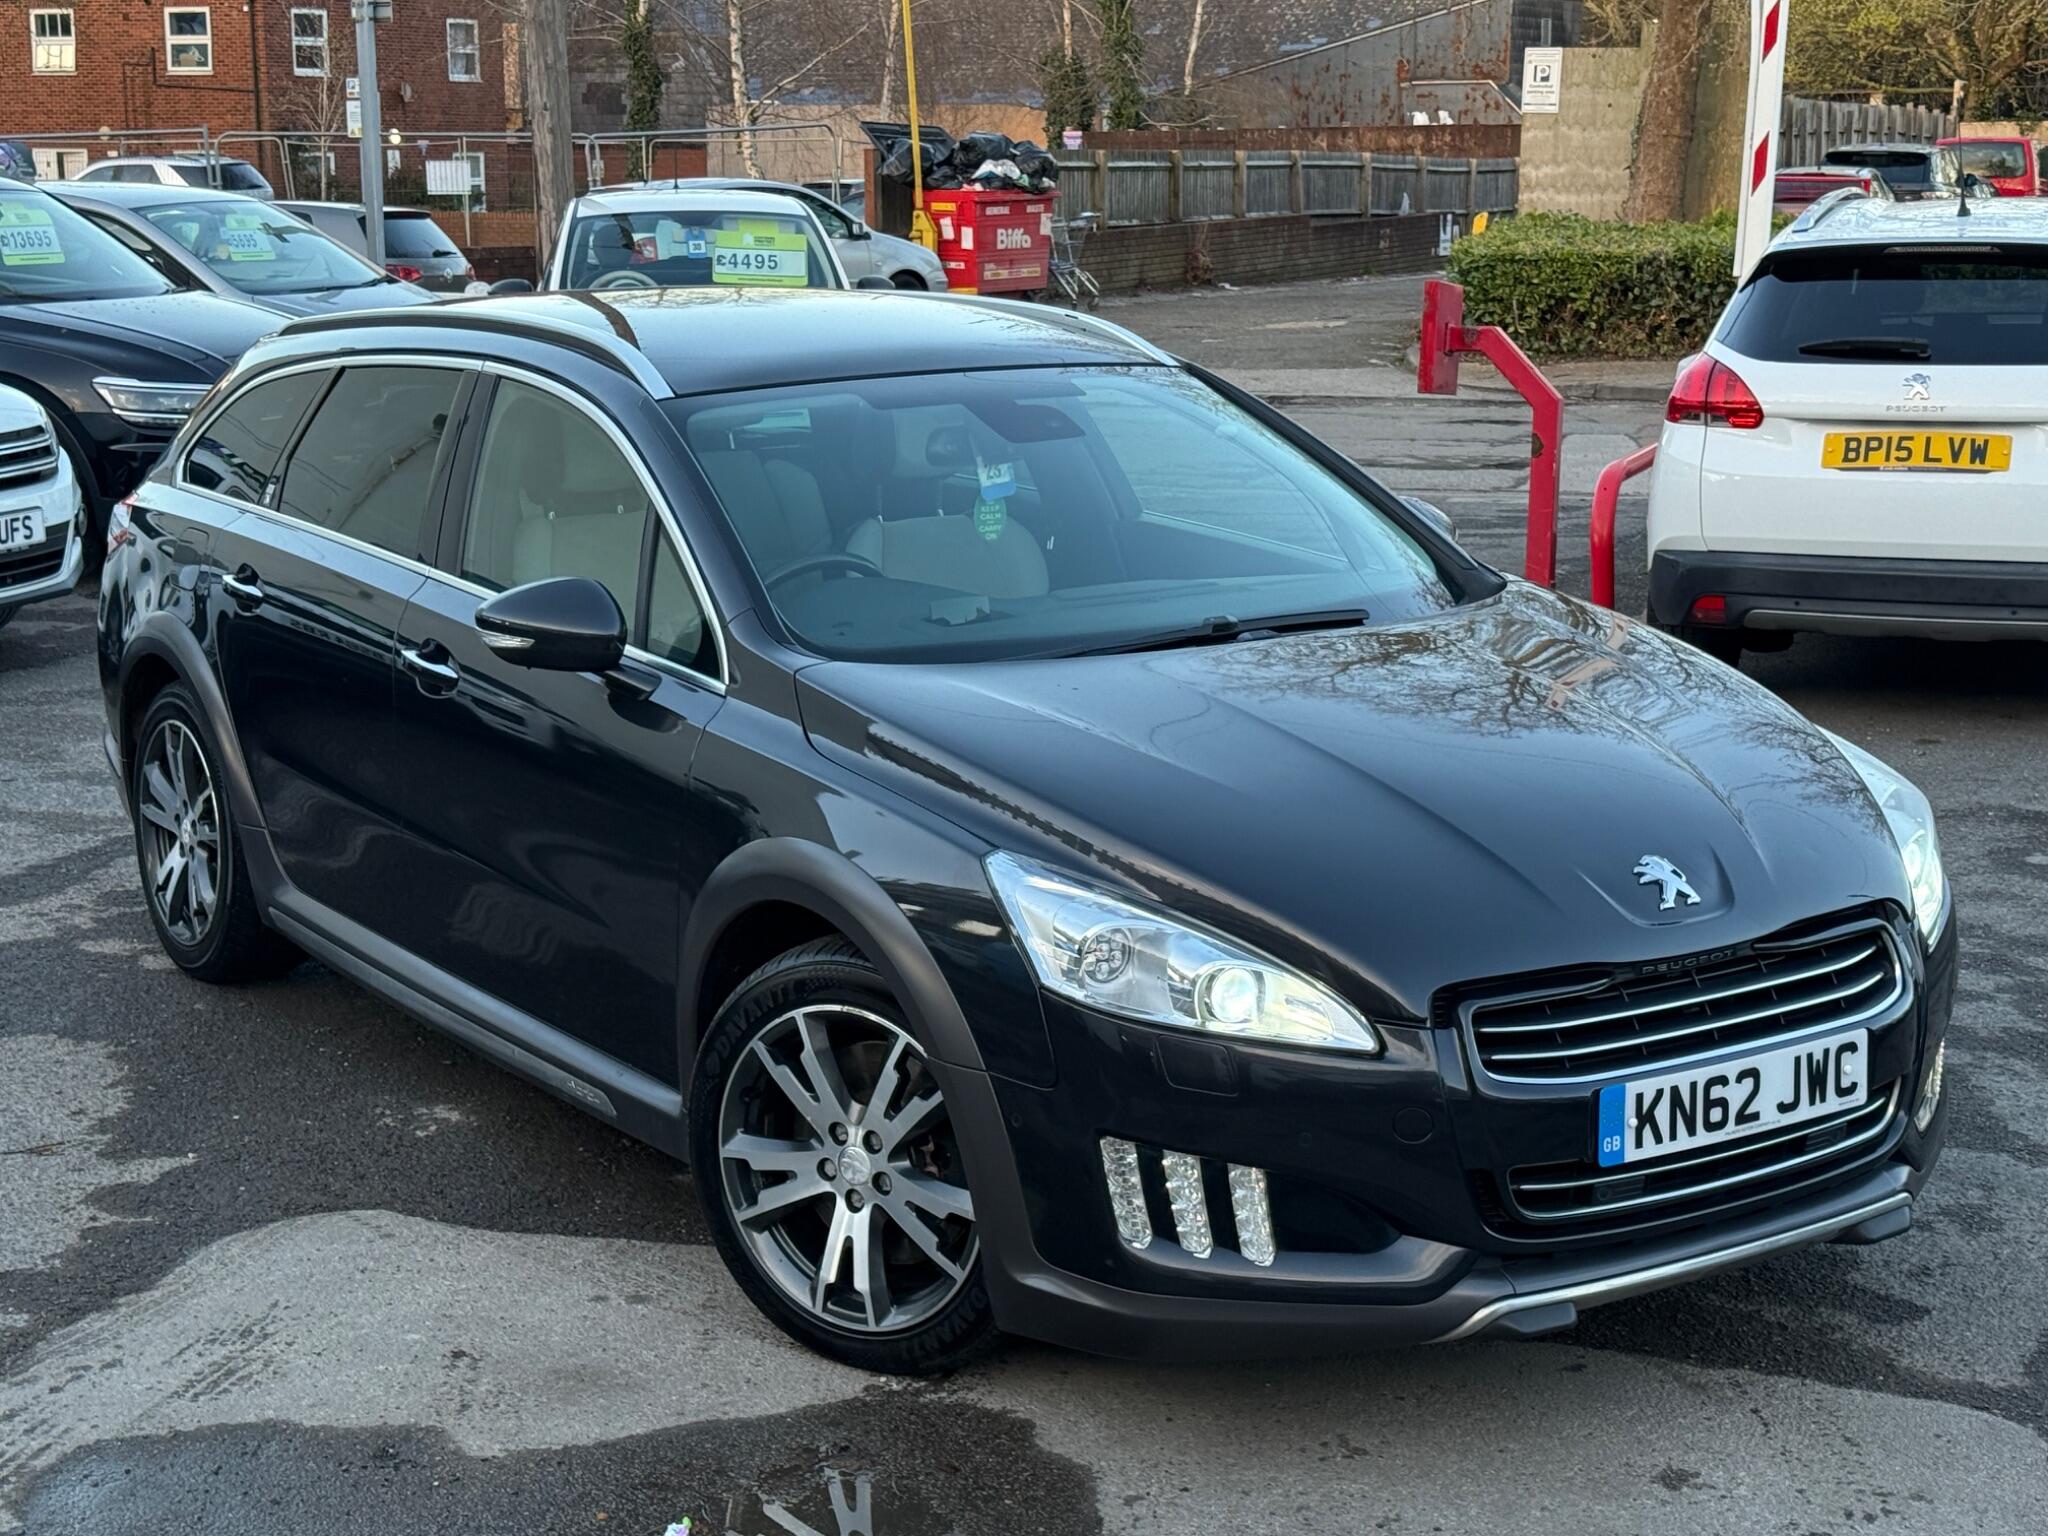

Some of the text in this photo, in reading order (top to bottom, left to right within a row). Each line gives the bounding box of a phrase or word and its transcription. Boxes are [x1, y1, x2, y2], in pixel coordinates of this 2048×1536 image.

[997, 228, 1031, 250] Biffa
[716, 253, 778, 270] £4495
[1885, 405, 1947, 413] PEUGEOT
[1841, 436, 1990, 465] BP15 LVW
[1642, 949, 1734, 974] PEUGEOT
[1634, 1041, 1859, 1150] KN62 JWC
[1603, 1135, 1621, 1153] GB
